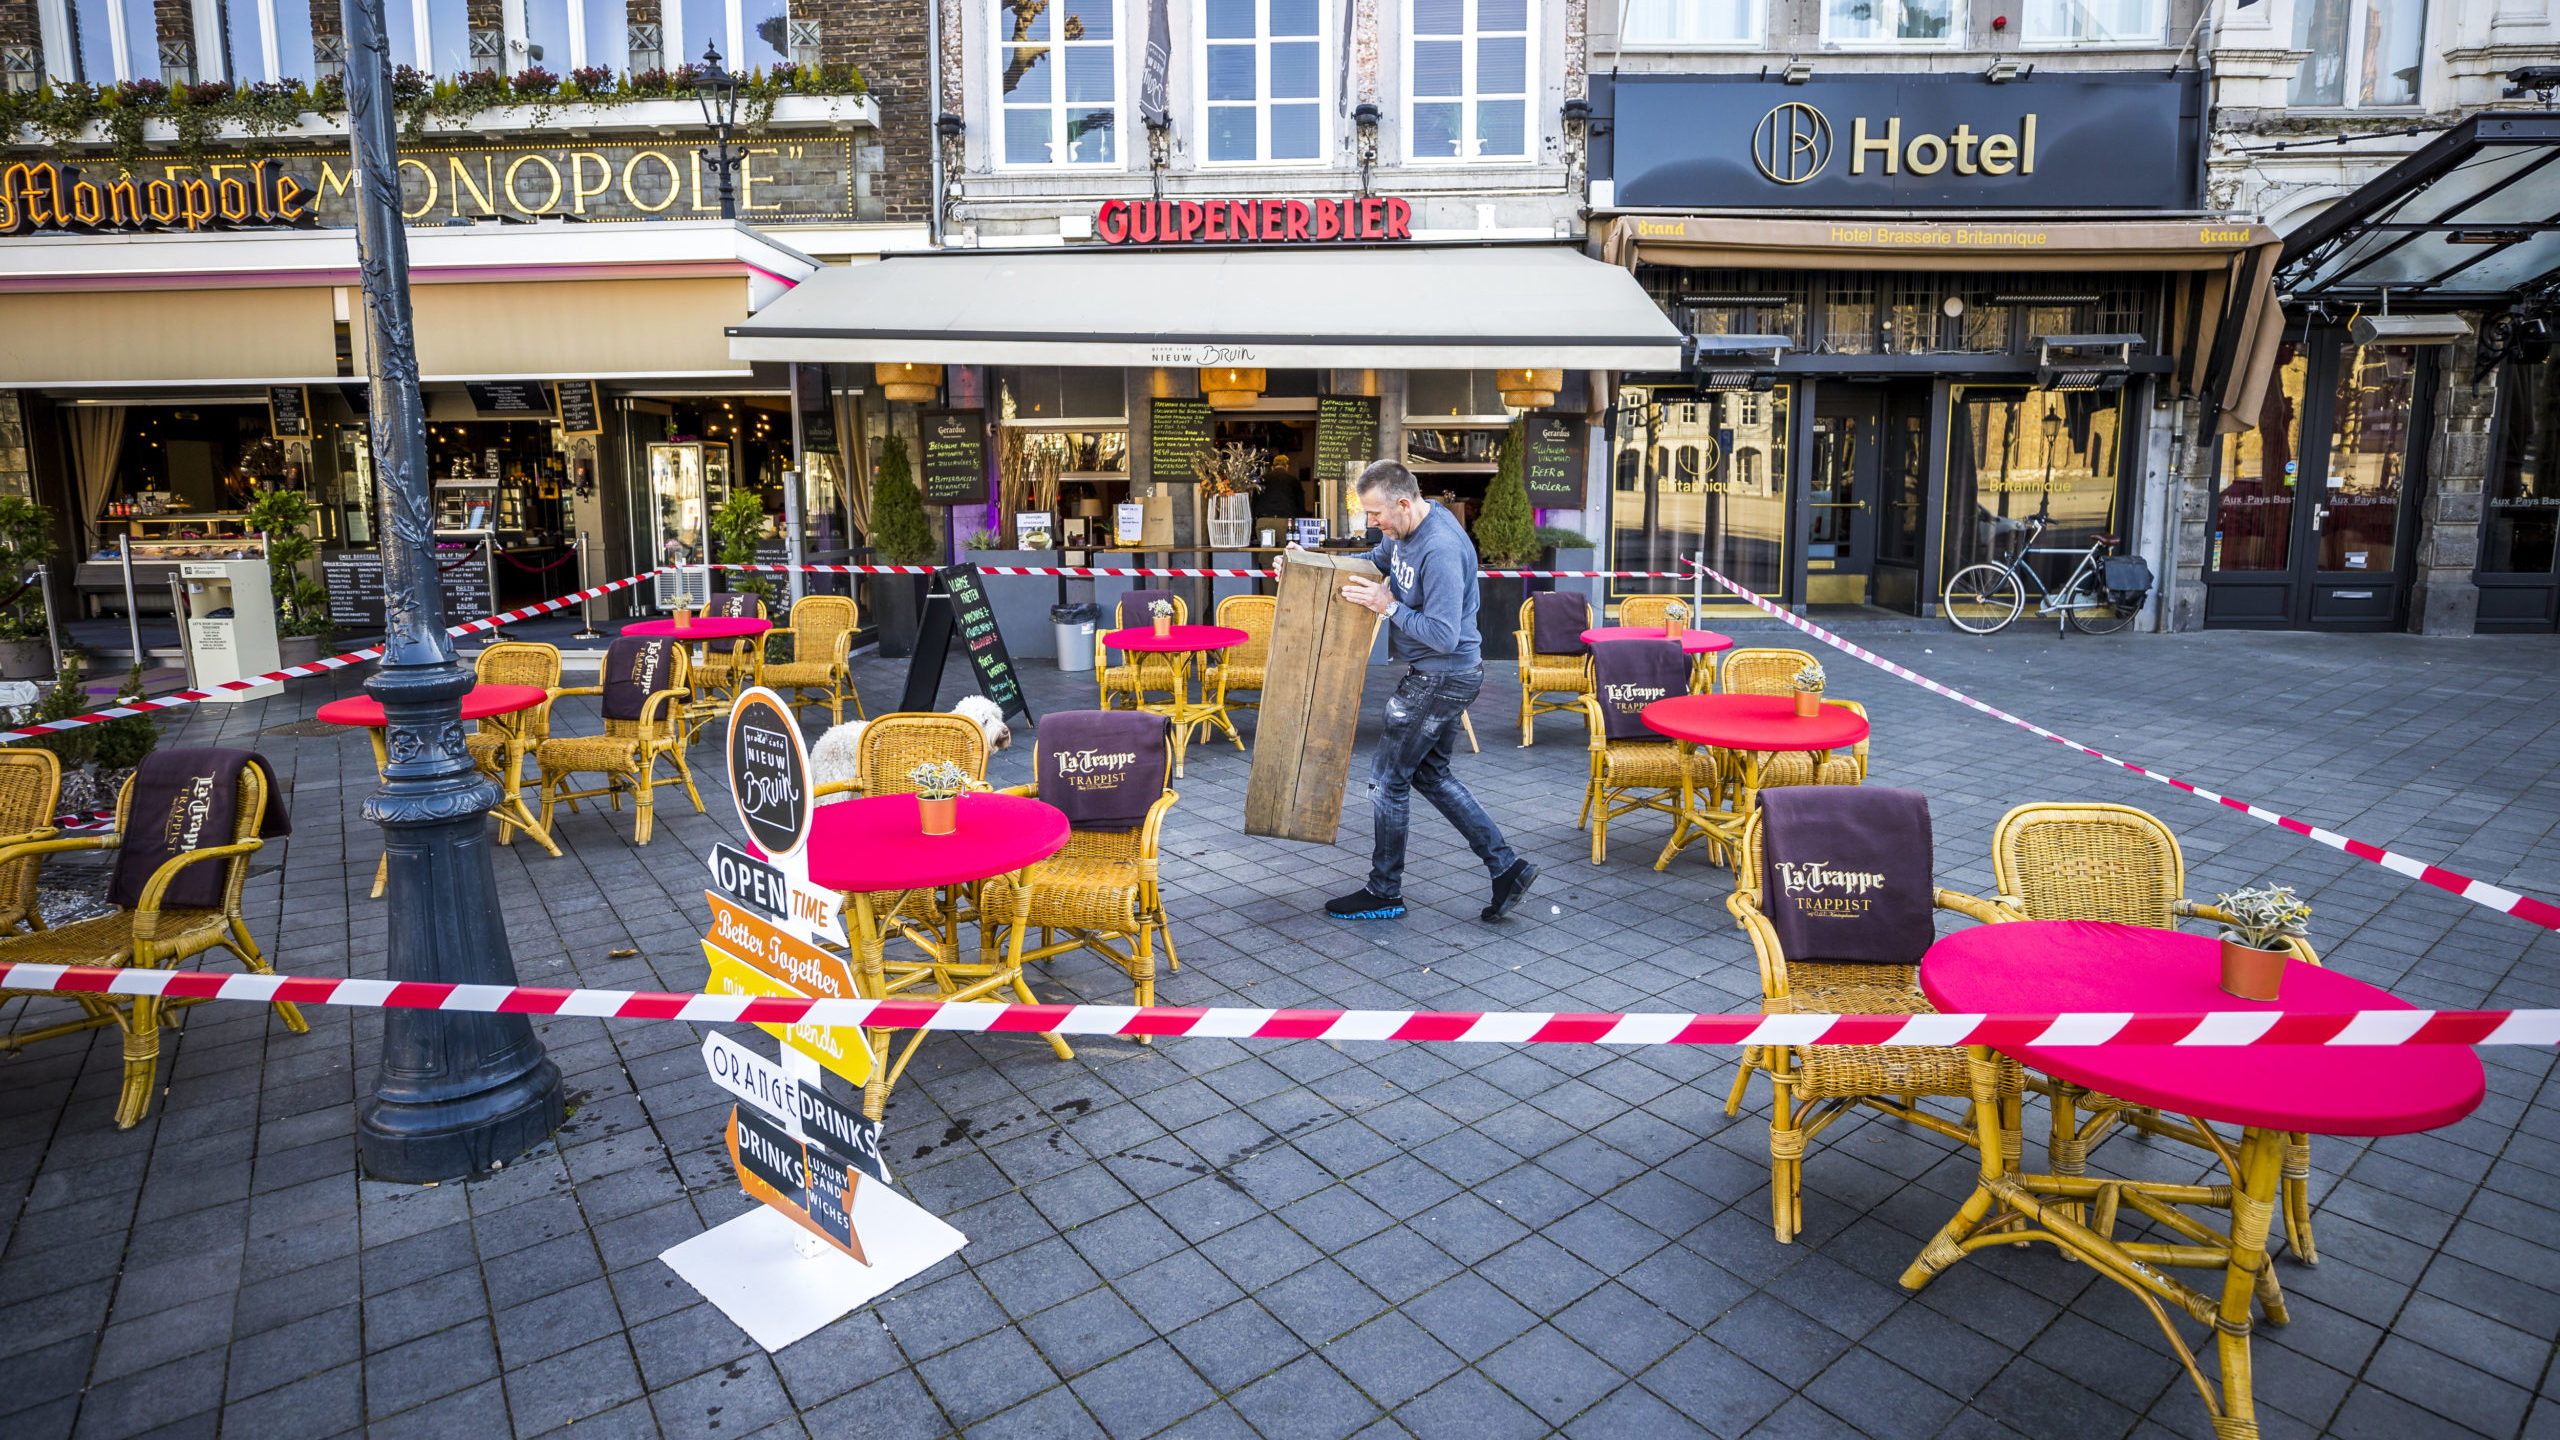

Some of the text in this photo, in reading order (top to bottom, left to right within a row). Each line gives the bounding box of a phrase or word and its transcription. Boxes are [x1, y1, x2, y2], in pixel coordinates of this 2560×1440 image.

[1852, 113, 2036, 175] Hotel
[0, 160, 306, 231] Monopole
[1638, 219, 1685, 236] Brand
[1831, 227, 2046, 247] Hotel Brasserie Britannique
[2200, 227, 2250, 244] Brand
[1152, 354, 1192, 362] NIEUW
[1989, 477, 2072, 494] Britannique
[2247, 495, 2271, 505] Pays
[2273, 495, 2291, 503] Bas
[2354, 496, 2377, 506] Pays
[2379, 496, 2398, 504] Bas
[2515, 497, 2539, 507] Pays
[2541, 497, 2560, 505] Bas
[748, 747, 785, 770] NIEUW
[1076, 748, 1137, 774] Trappe
[1068, 772, 1127, 786] TRAPPIST
[167, 785, 190, 854] TRAPPIST
[1802, 860, 1886, 895] Trappe
[719, 856, 828, 928] OPEN TIME
[1794, 897, 1872, 911] TRAPPIST
[717, 909, 841, 999] Better Together
[713, 1045, 876, 1159] ORANGE DRINKS
[737, 1120, 805, 1189] DRINKS
[807, 1154, 849, 1188] LUXURY
[812, 1172, 842, 1199] SAND
[808, 1189, 850, 1229] WICHES
